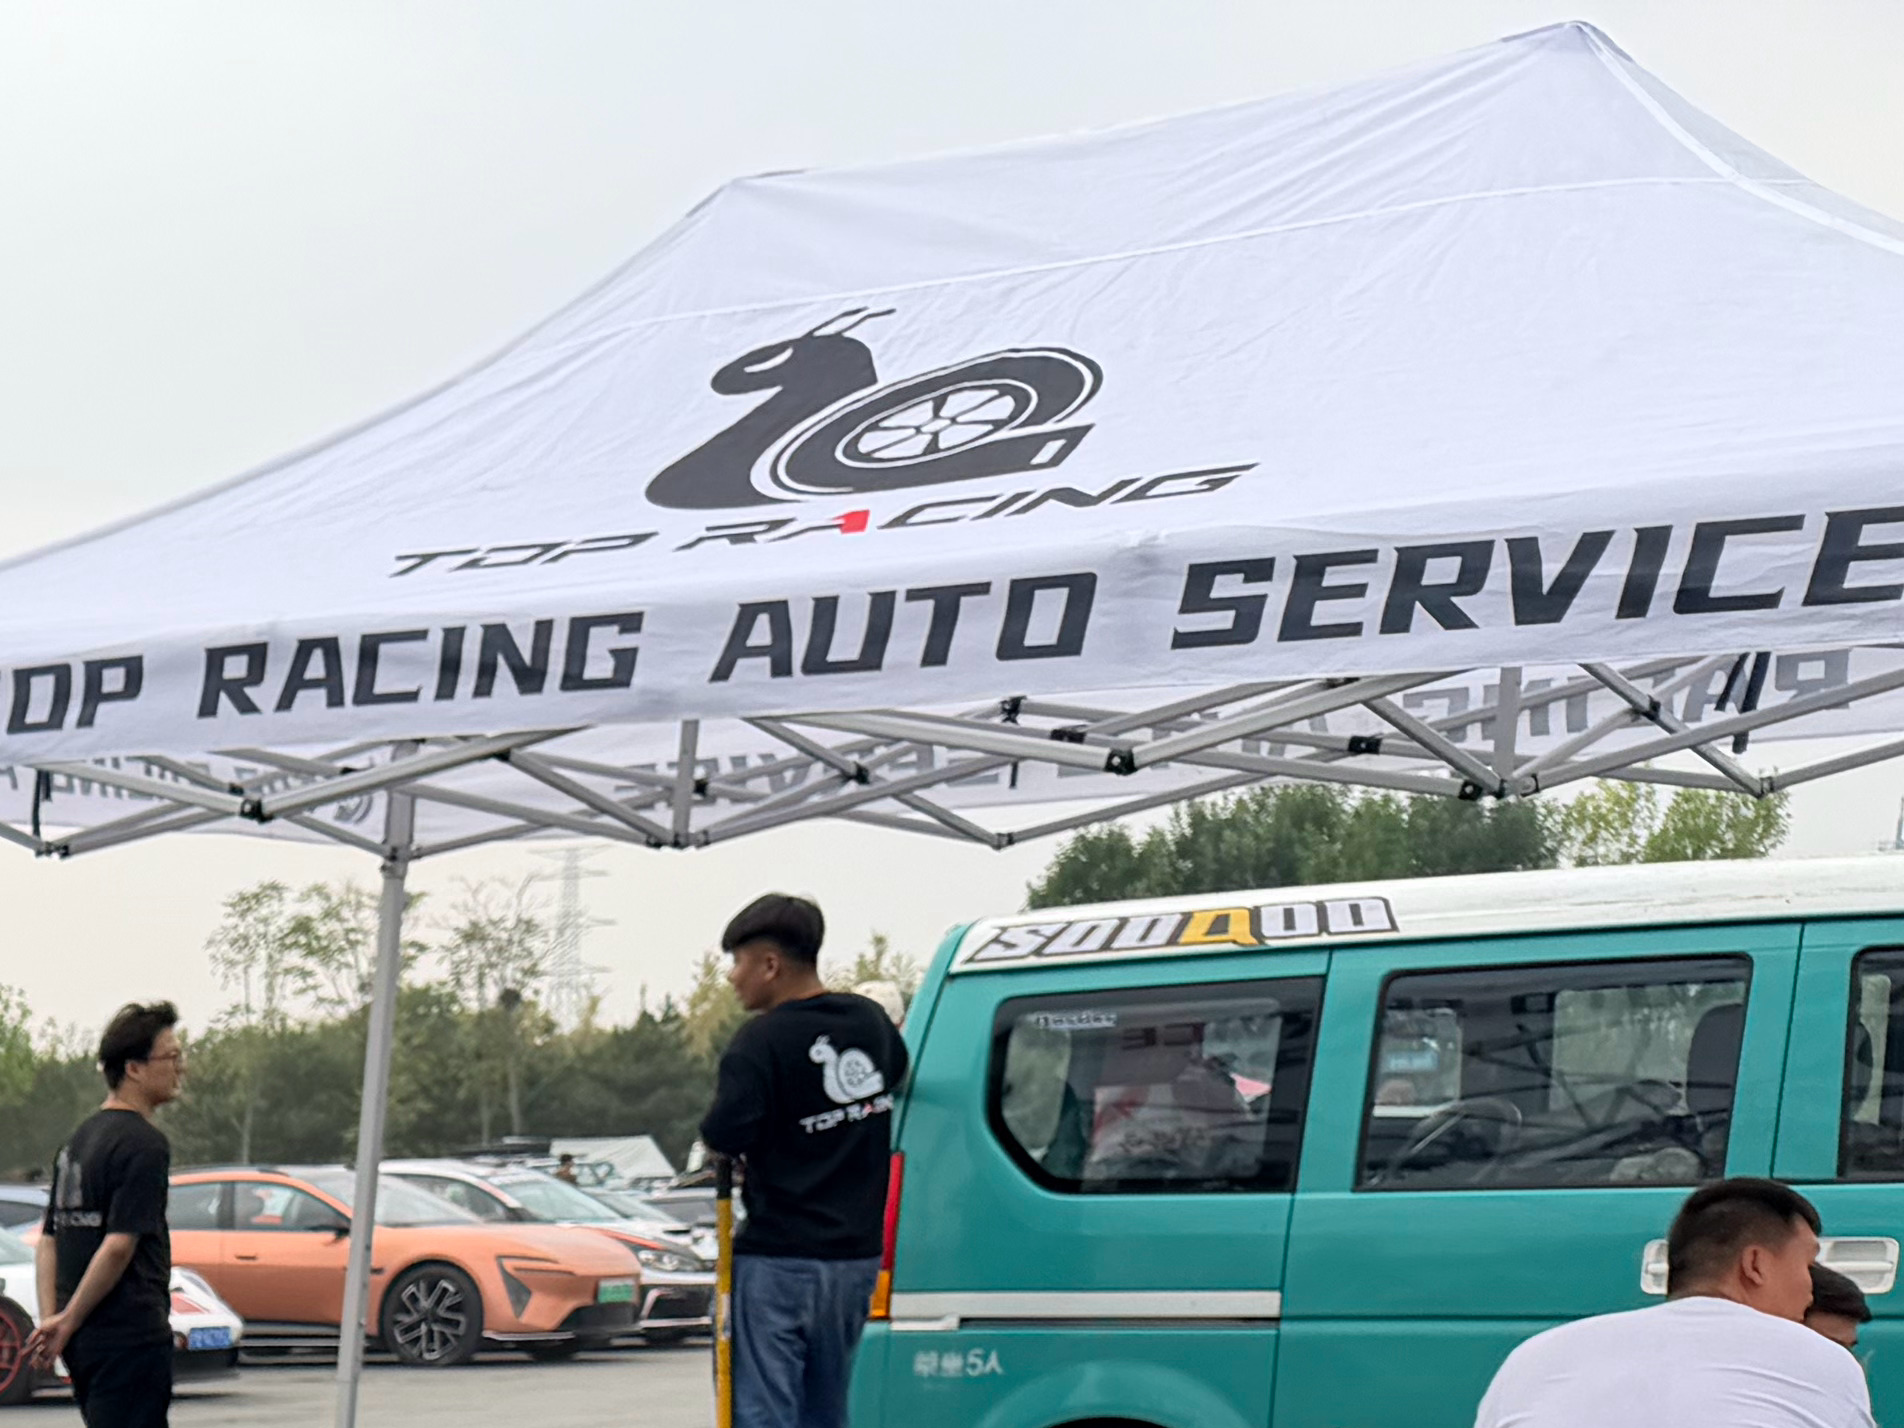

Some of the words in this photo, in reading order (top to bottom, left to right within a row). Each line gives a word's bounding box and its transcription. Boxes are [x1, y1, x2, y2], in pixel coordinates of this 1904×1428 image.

[388, 530, 660, 578] TOP
[673, 461, 1261, 552] RACING
[196, 610, 645, 720] RACING
[708, 571, 1098, 684] AUTO
[1170, 504, 1904, 650] SERVICE
[799, 1108, 845, 1133] TOP
